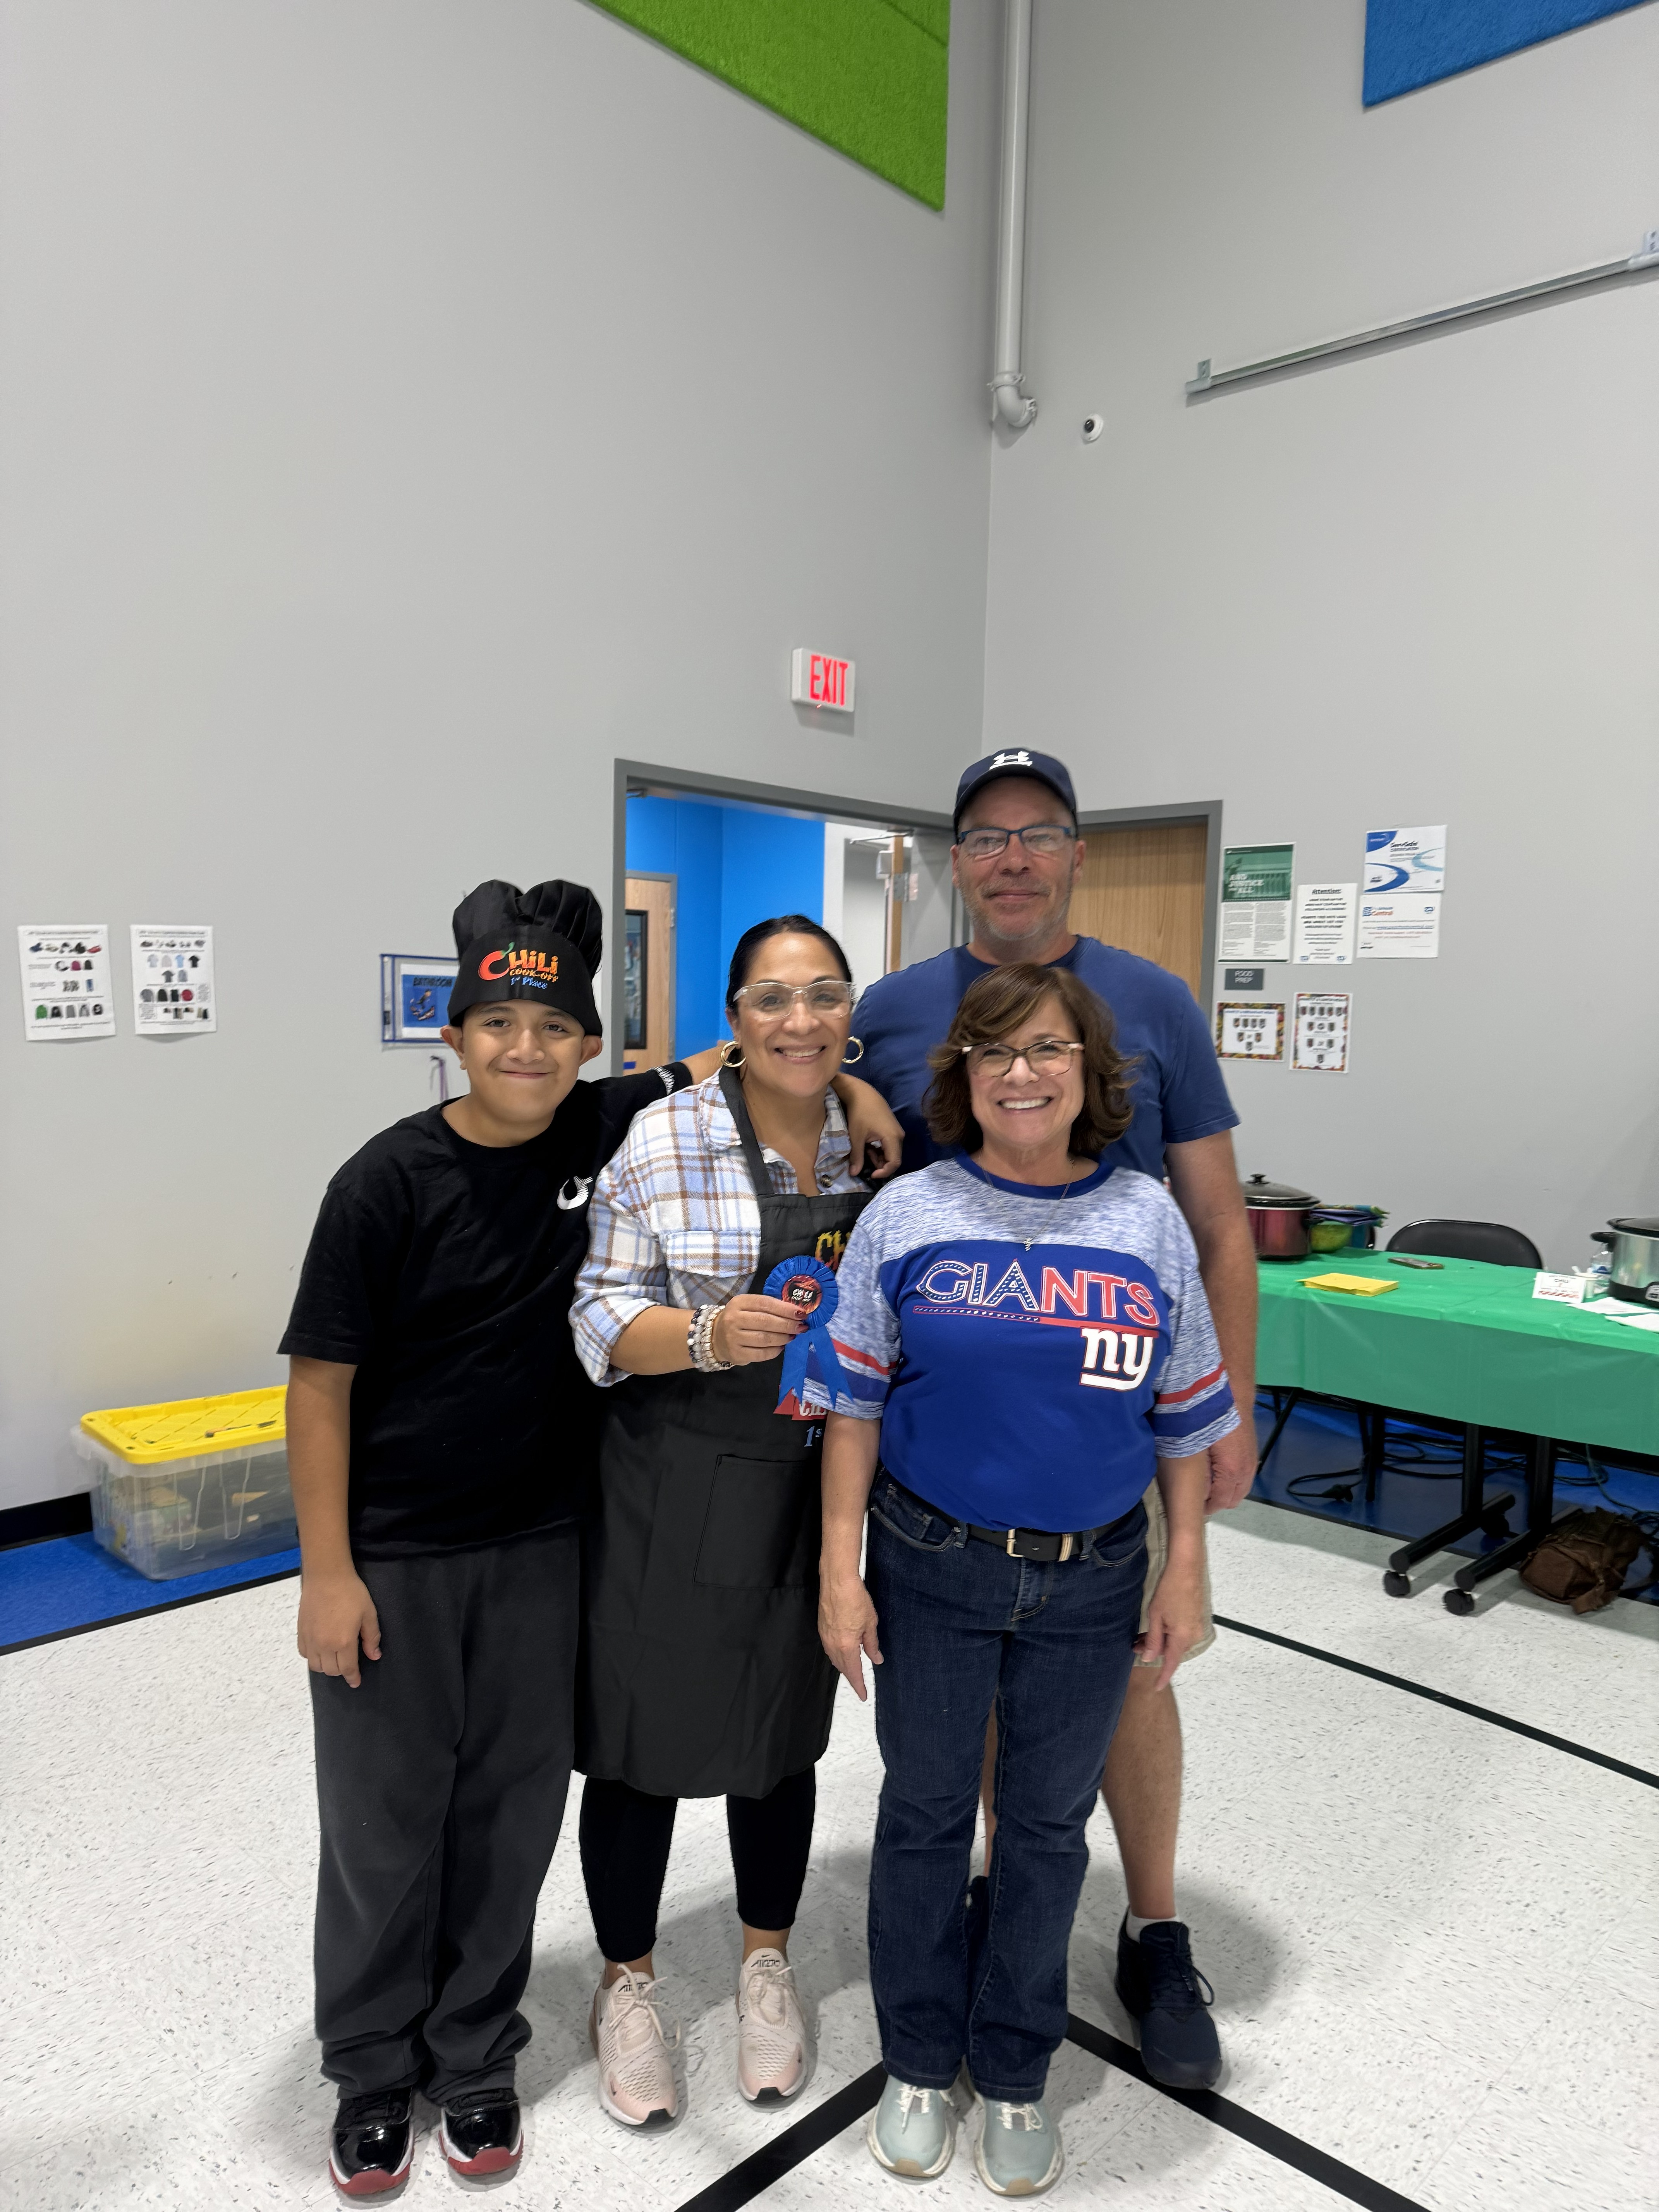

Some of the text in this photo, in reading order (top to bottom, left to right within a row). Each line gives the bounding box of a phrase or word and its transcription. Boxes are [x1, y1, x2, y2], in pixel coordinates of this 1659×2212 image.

[809, 654, 848, 706] EXIT
[916, 1259, 1160, 1326] GIANTS
[804, 1425, 823, 1447] 1s
